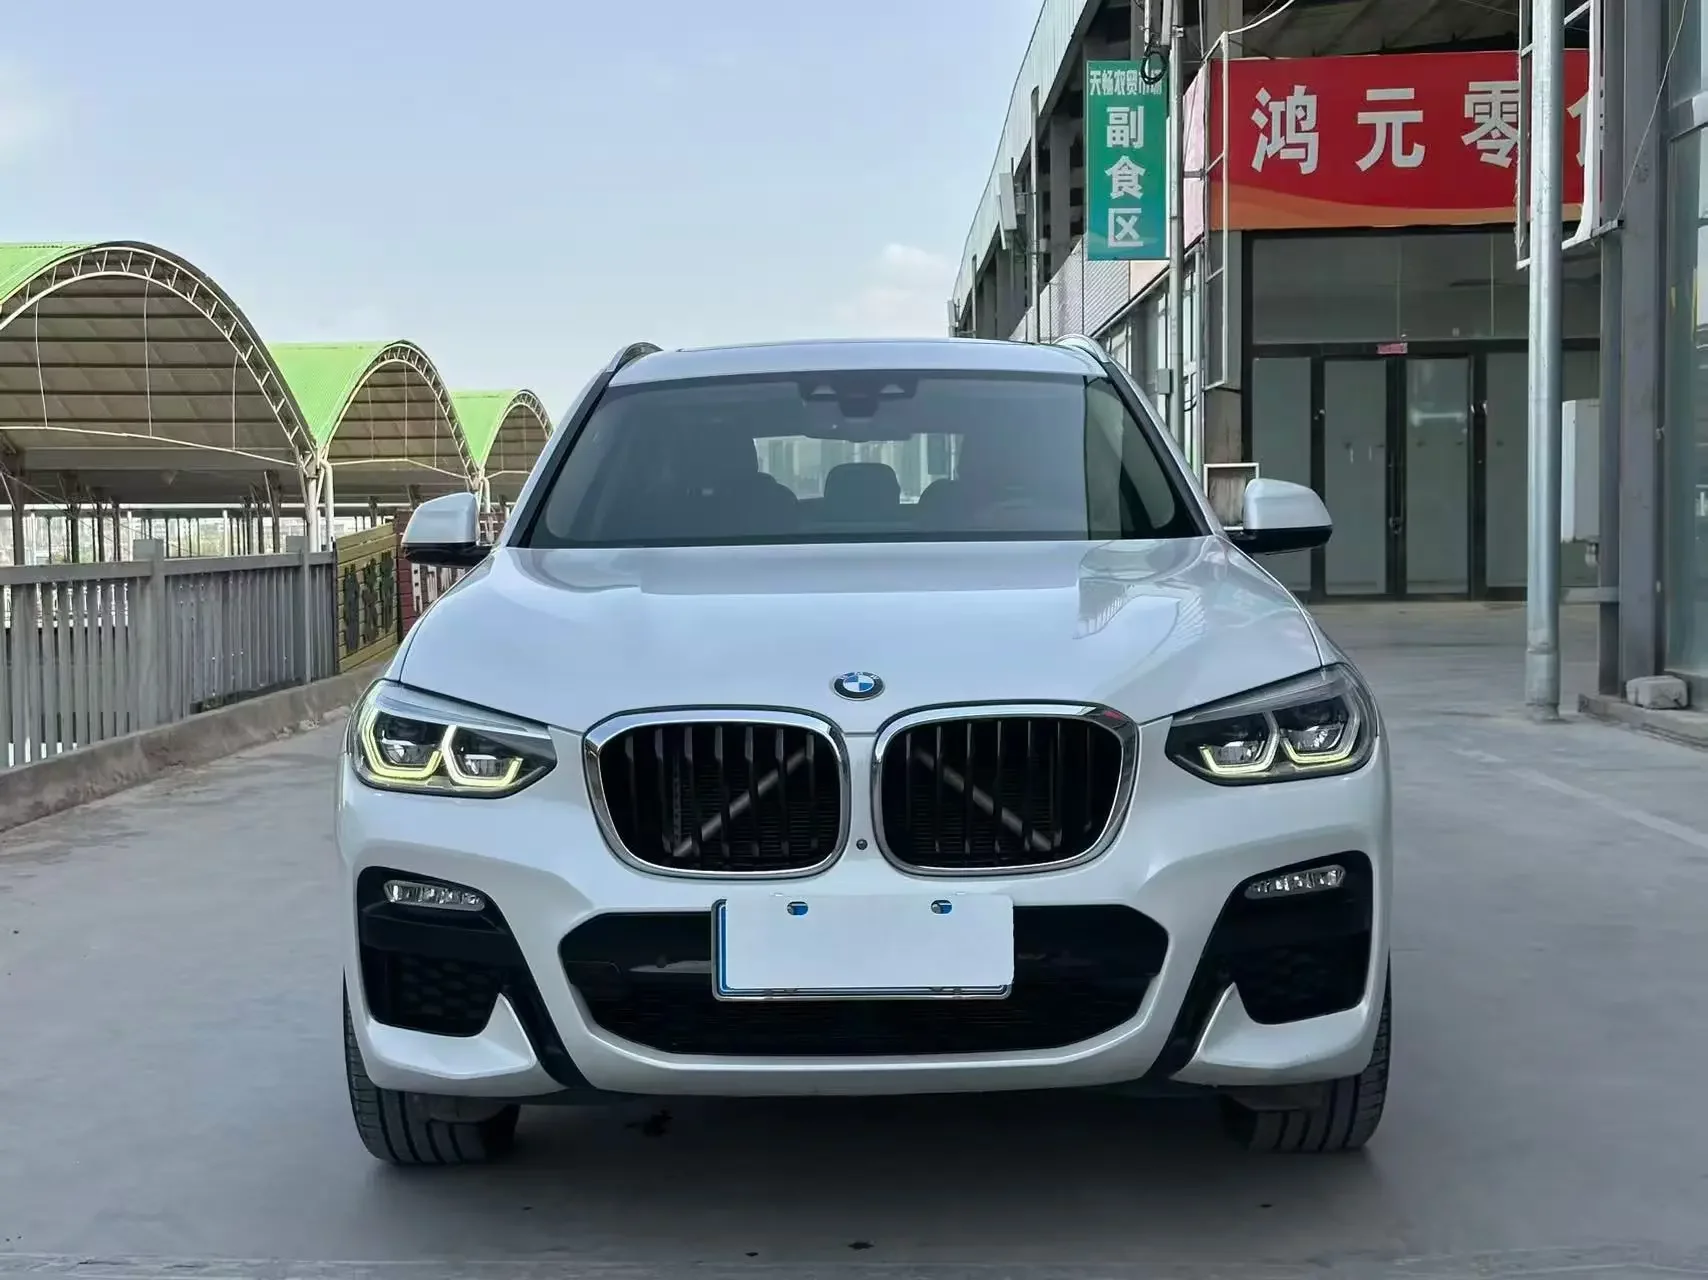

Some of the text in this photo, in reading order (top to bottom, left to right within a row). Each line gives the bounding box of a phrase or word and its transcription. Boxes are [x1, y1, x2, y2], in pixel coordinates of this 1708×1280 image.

[1104, 105, 1146, 248] 副食区
[1250, 80, 1590, 176] 鸿元零
